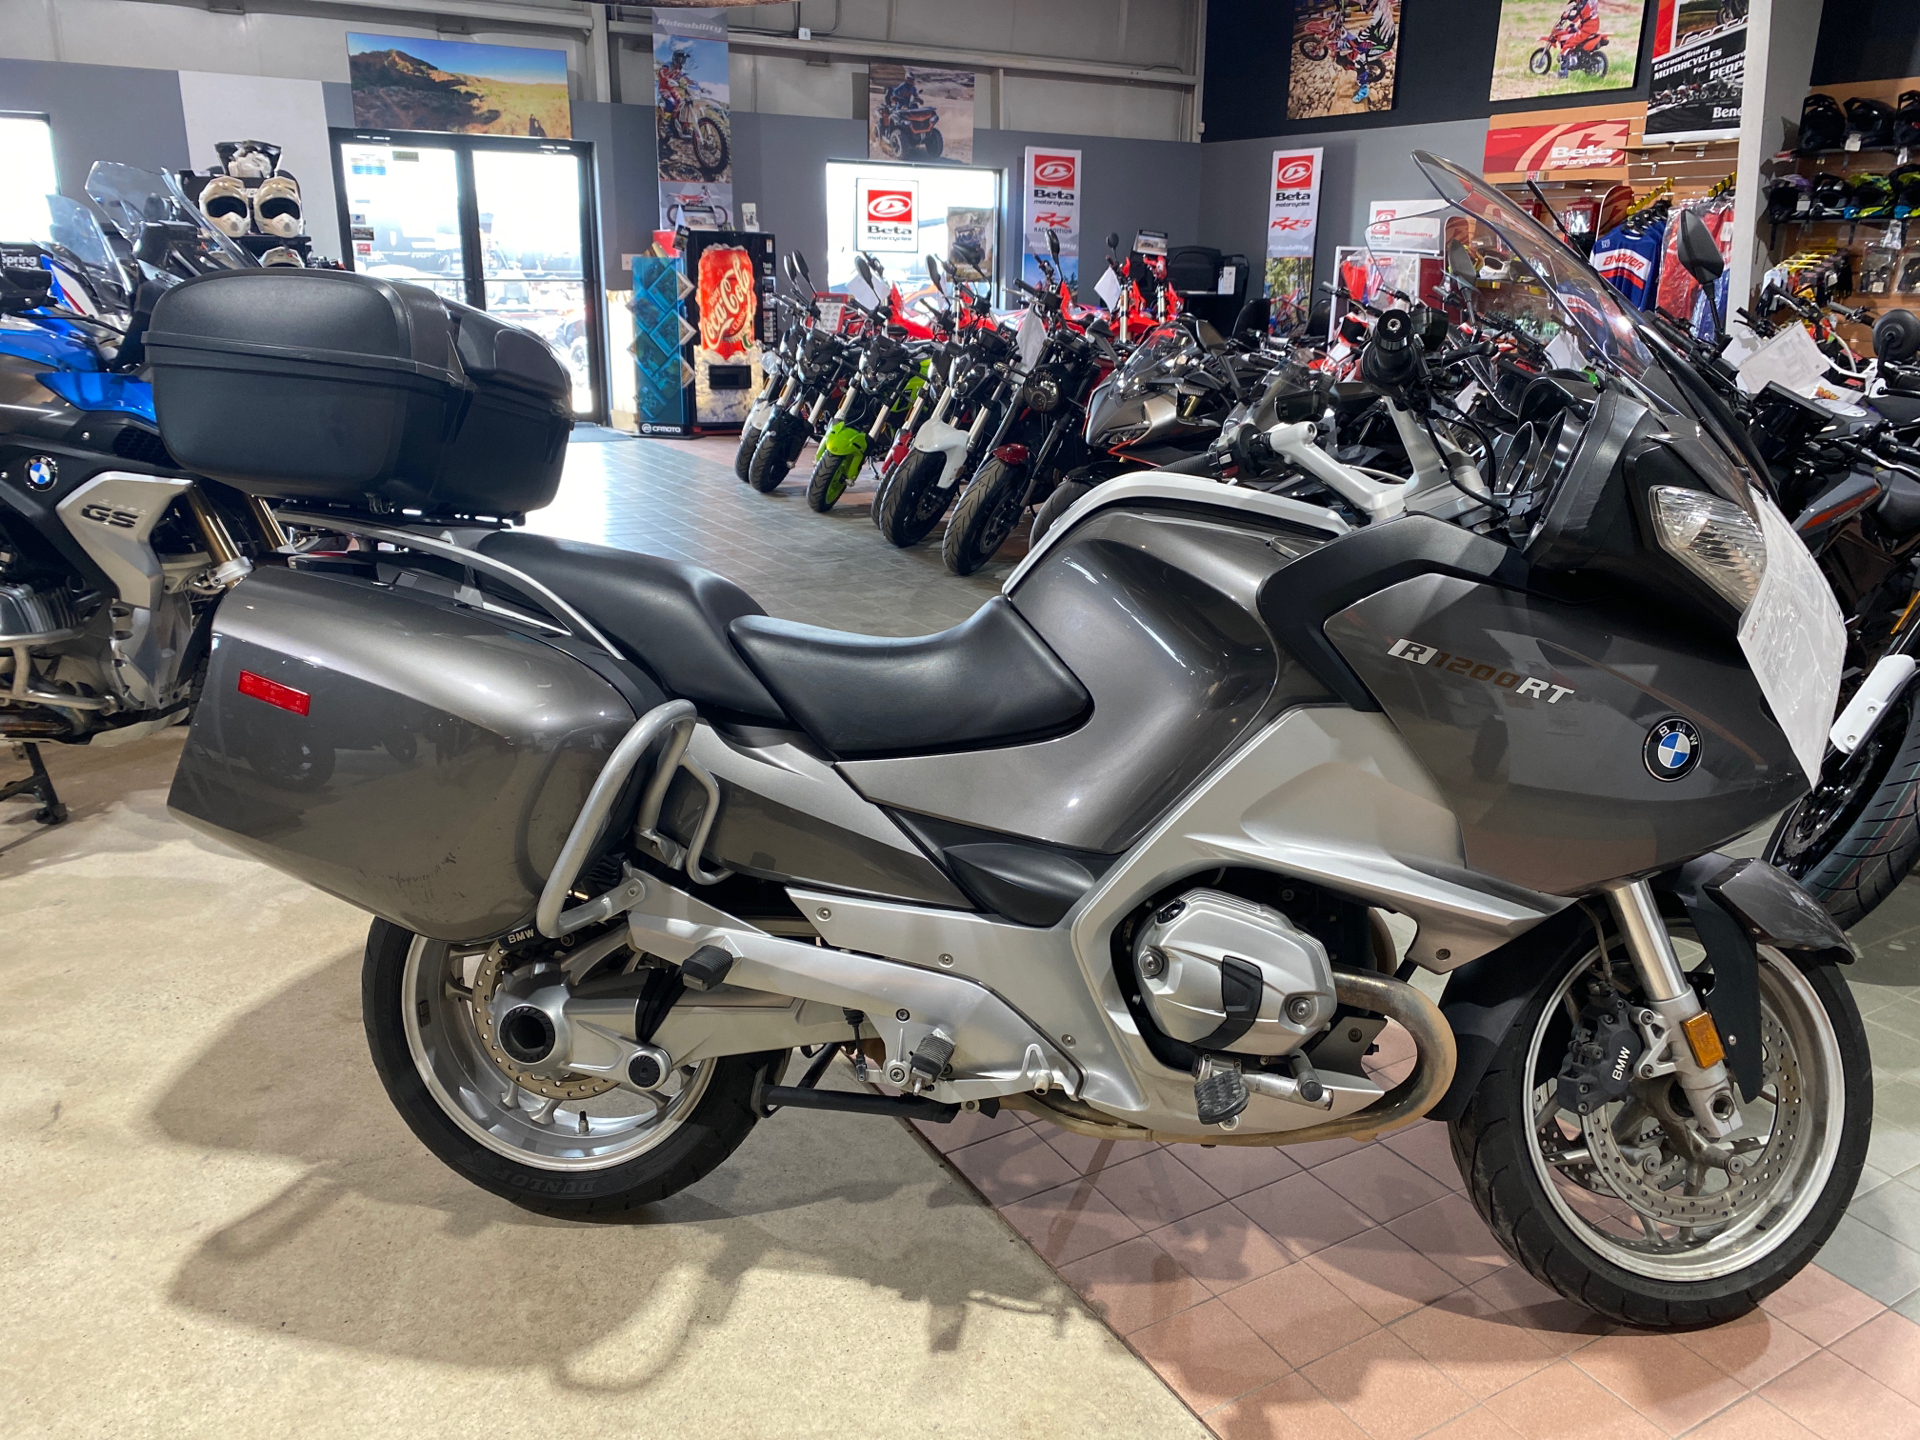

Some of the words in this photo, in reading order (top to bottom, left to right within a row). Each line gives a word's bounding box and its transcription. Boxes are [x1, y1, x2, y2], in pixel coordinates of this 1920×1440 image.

[657, 18, 723, 34] Rideability
[1653, 45, 1711, 71] Extraordinary
[1653, 48, 1723, 80] MOTORCYCLES
[1693, 64, 1708, 75] For
[1550, 145, 1614, 159] Beta
[1550, 157, 1612, 166] motorcycles
[1034, 189, 1075, 201] Beta
[1275, 192, 1311, 202] Beta
[1033, 199, 1075, 207] motorcycles
[867, 225, 912, 235] Beta
[703, 253, 750, 350] Coca-Cola
[652, 425, 682, 433] CFMOTO
[81, 503, 139, 529] GS
[507, 929, 535, 944] BMW
[1611, 1046, 1631, 1081] BMW
